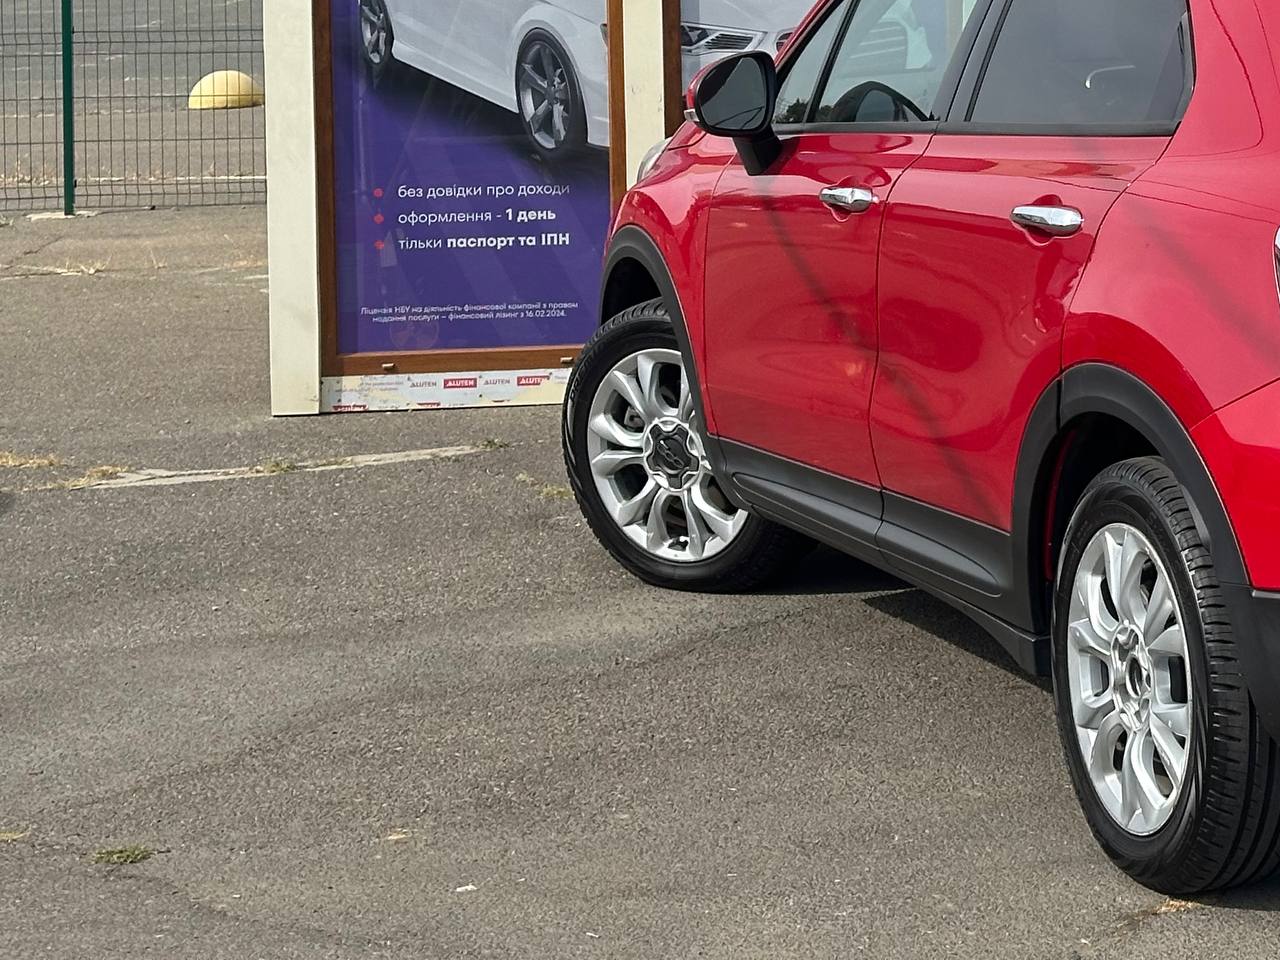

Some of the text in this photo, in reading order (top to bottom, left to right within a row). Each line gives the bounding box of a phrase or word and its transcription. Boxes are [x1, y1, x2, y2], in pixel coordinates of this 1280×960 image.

[398, 184, 570, 199] без довідки про доходи
[398, 210, 492, 226] оформлення
[505, 208, 513, 221] 1
[517, 209, 557, 223] день
[398, 232, 570, 250] тільки паспорт та ІПН
